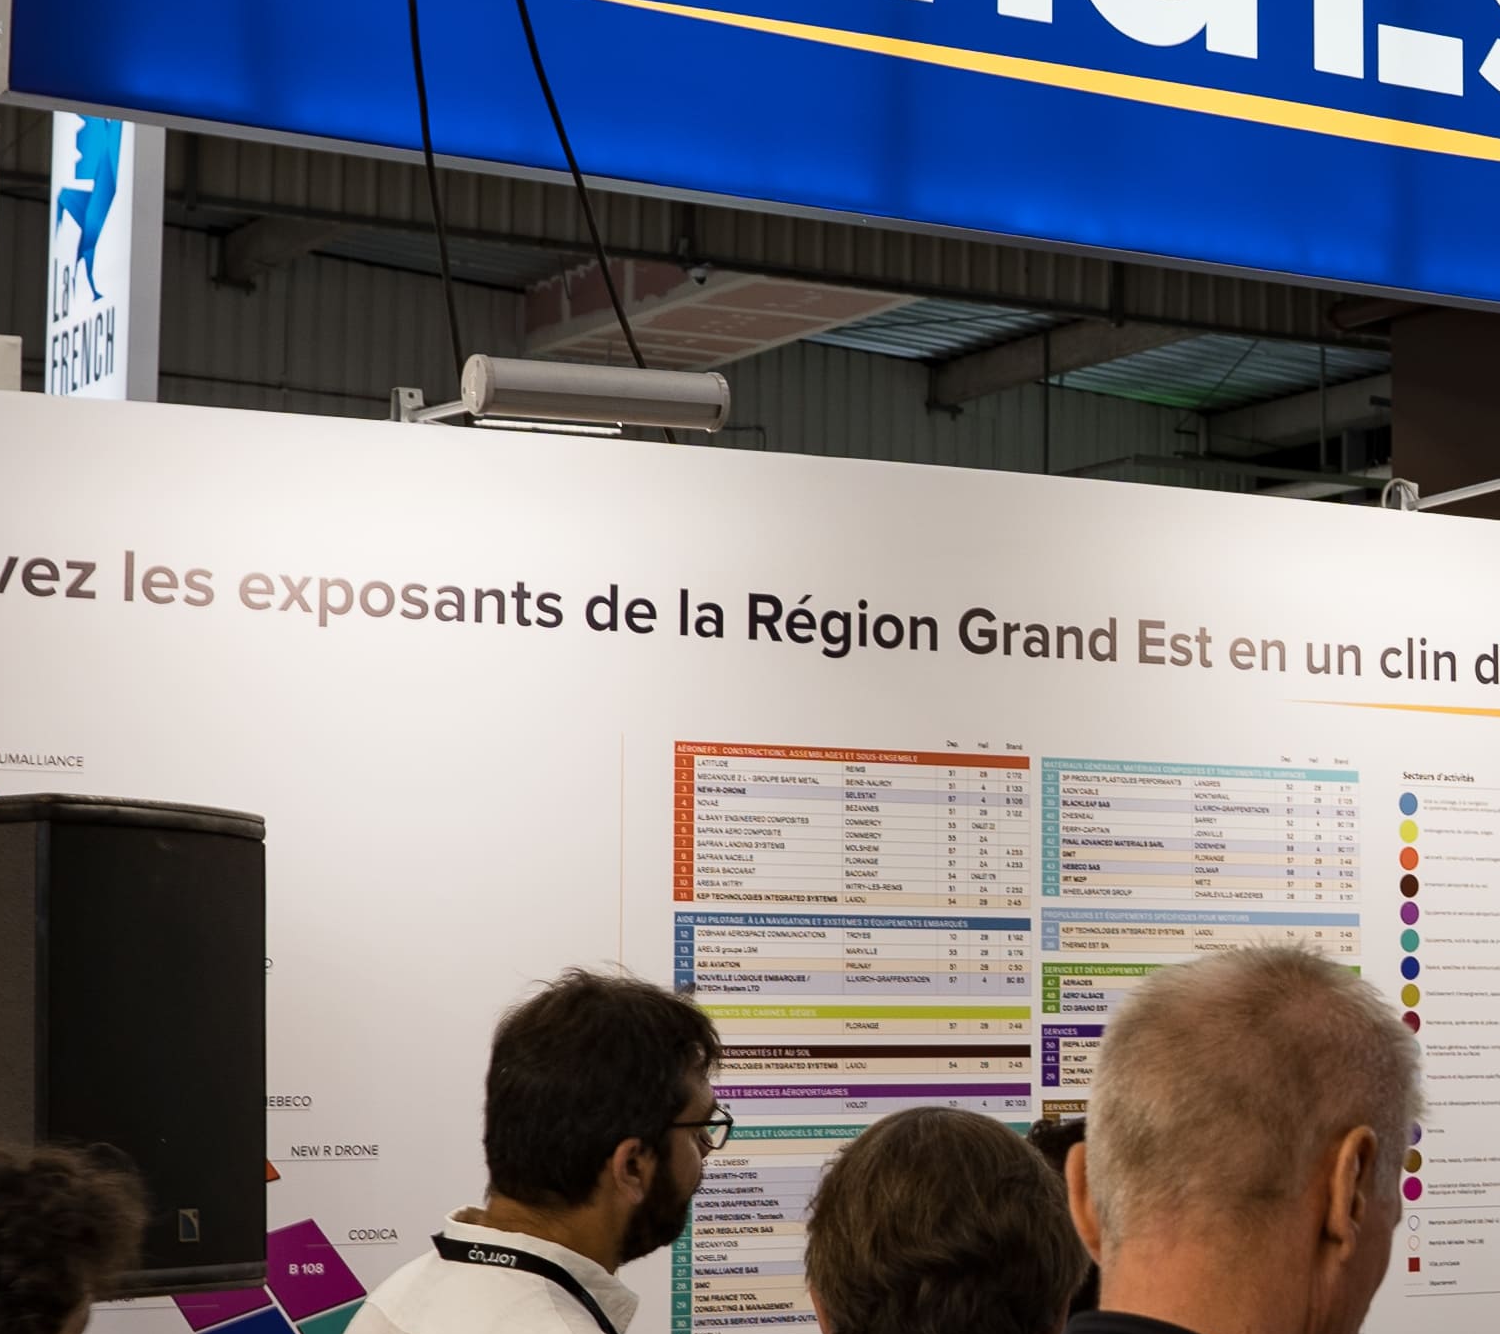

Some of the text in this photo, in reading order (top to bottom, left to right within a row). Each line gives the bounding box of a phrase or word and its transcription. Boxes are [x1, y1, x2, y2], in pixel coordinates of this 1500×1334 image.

[52, 306, 115, 395] FRENCH
[123, 550, 215, 608] les
[238, 564, 563, 630] exposants
[584, 585, 658, 634] de
[678, 590, 727, 639] la
[746, 591, 939, 663] Région
[958, 607, 1119, 666] Grand
[1137, 618, 1215, 670] Est
[1228, 630, 1288, 673] en
[1306, 634, 1363, 678] un
[1379, 637, 1458, 685] clin
[1403, 772, 1435, 782] Secteurs
[676, 915, 695, 924] AIDE
[696, 916, 707, 924] AU
[754, 916, 765, 924] LA
[769, 917, 811, 925] NAVIGATION
[1044, 1028, 1078, 1036] SERVICES
[291, 1145, 378, 1157] NEW R DRONE
[348, 1229, 397, 1241] CODICA
[289, 1263, 324, 1275] B 108
